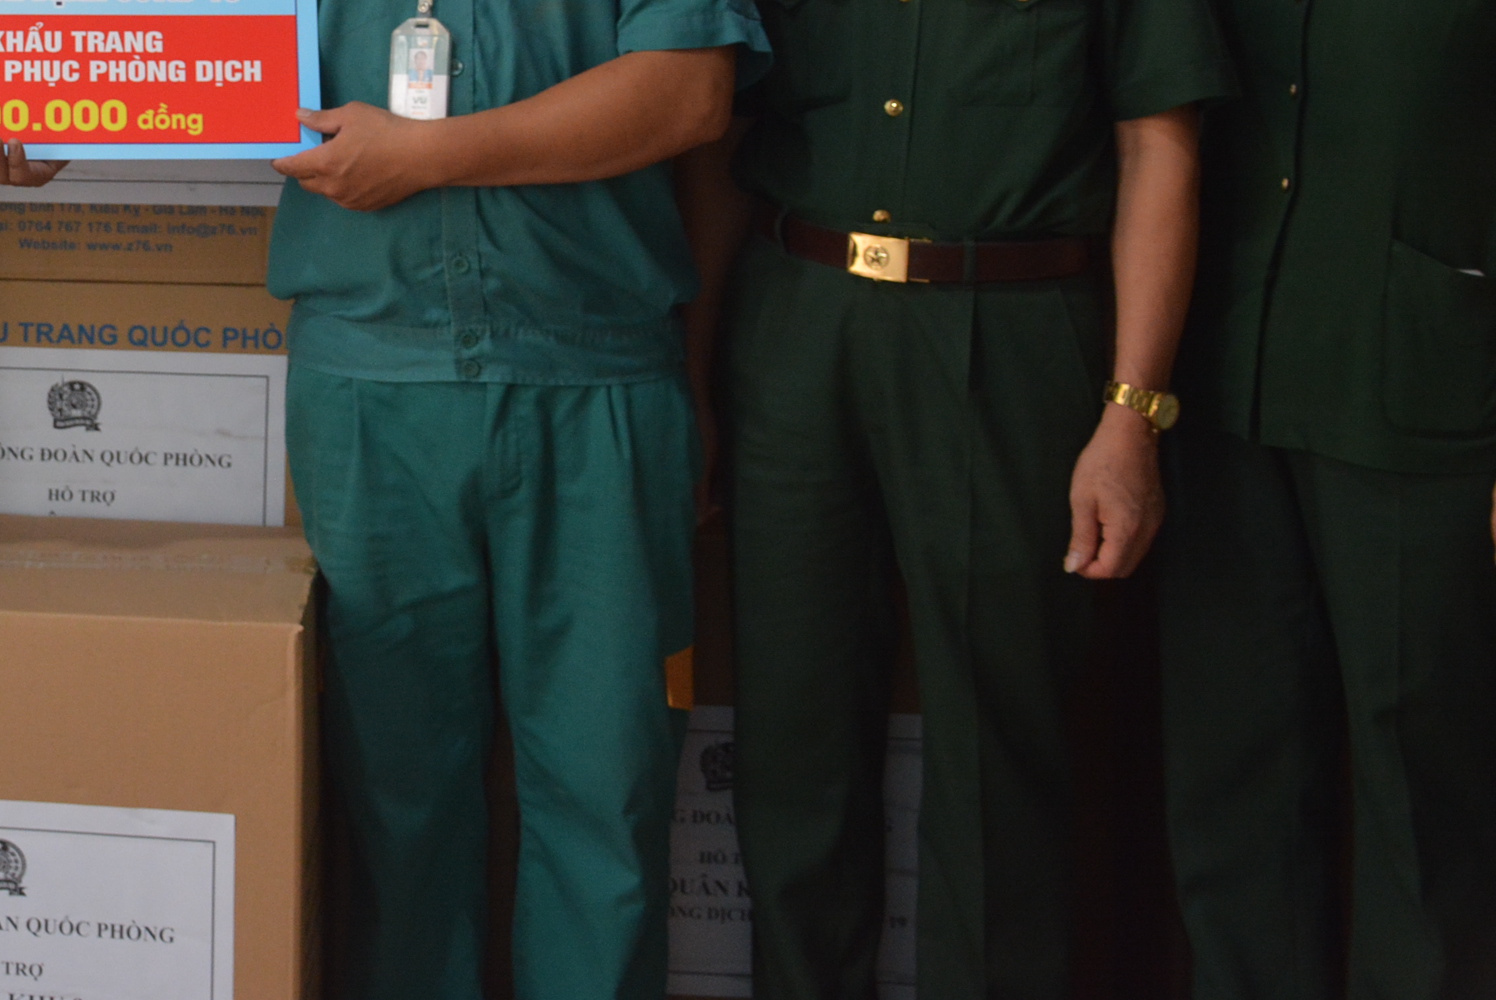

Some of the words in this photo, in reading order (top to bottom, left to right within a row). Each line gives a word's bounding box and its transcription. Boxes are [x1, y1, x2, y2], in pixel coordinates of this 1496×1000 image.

[71, 31, 164, 54] TRANG
[5, 59, 80, 87] PHỤC
[90, 54, 186, 83] PHÒNG
[196, 59, 262, 87] DỊCH
[137, 102, 204, 136] đồng
[18, 321, 118, 346] TRANG
[127, 319, 212, 348] QUỐC
[40, 445, 96, 464] ĐOÀN
[163, 448, 233, 469] PHÒNG
[97, 919, 175, 944] PHÒNG
